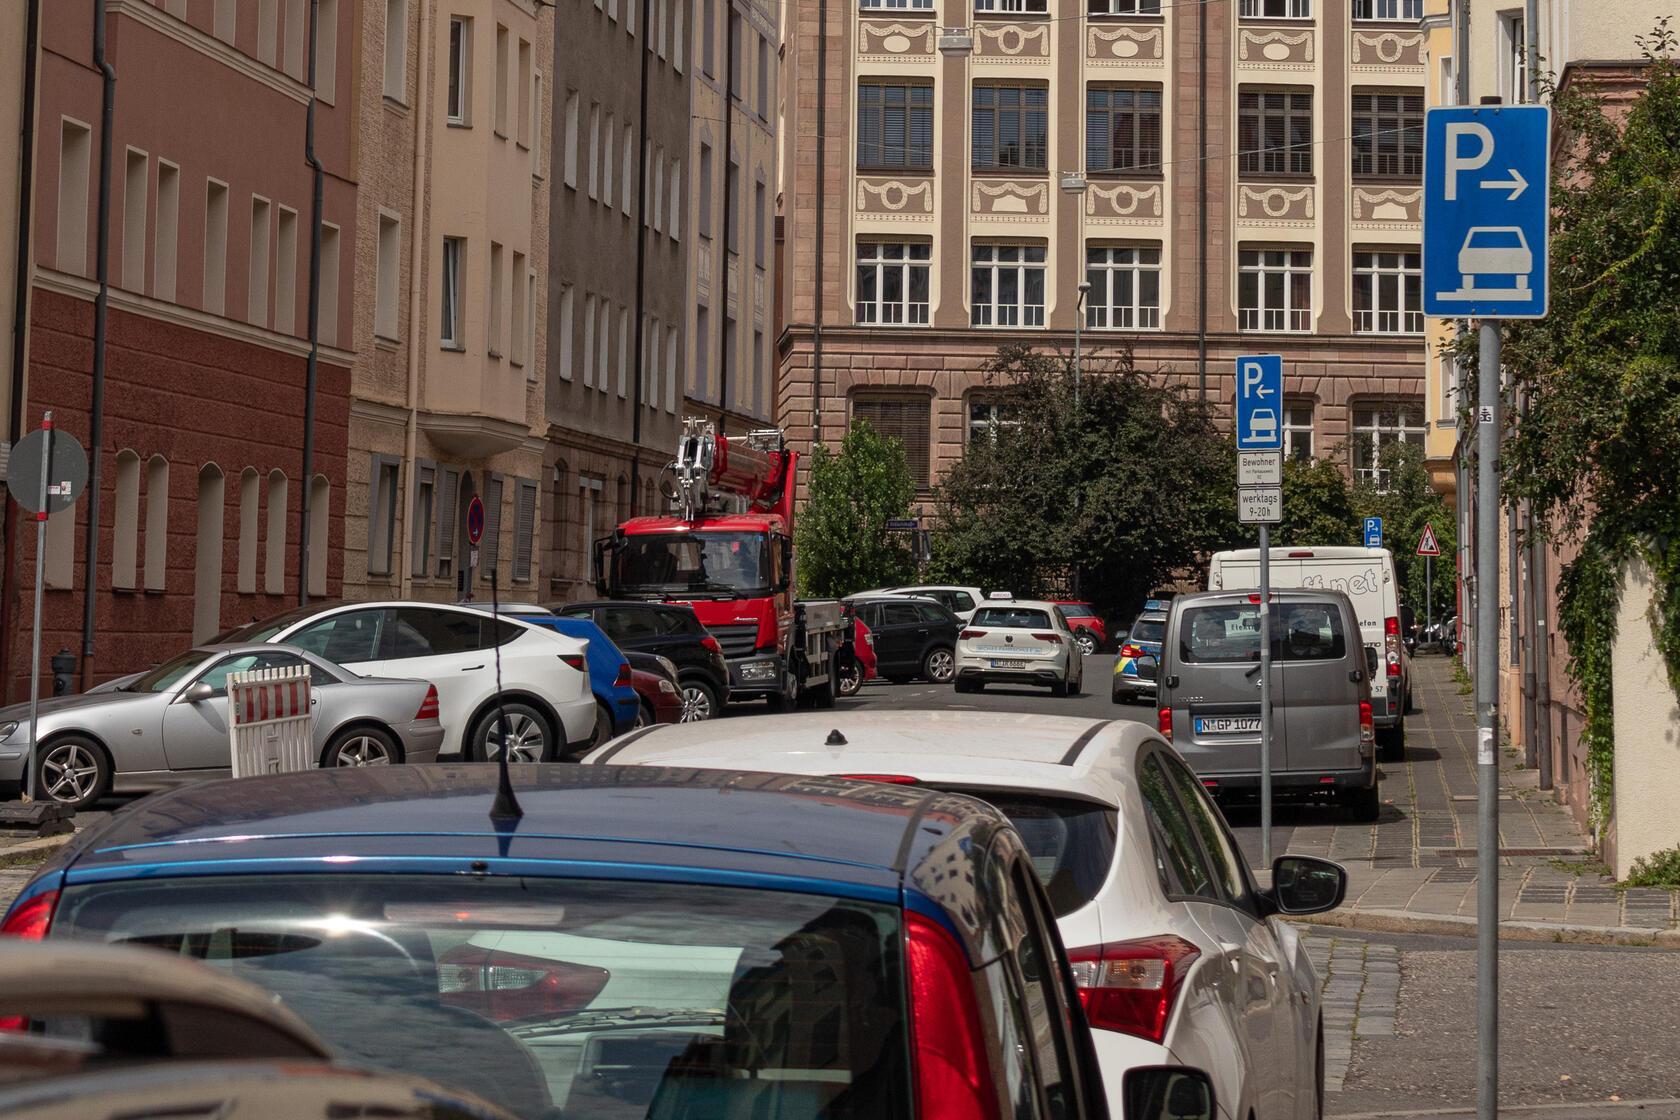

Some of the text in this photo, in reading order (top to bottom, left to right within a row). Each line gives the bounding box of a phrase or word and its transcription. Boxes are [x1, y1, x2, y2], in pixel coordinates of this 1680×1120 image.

[1444, 122, 1495, 201] P
[1244, 362, 1263, 398] P
[1242, 457, 1276, 467] Bewohner
[1242, 493, 1278, 505] werktags
[1367, 520, 1375, 532] P
[1202, 718, 1261, 731] N GP 1077
